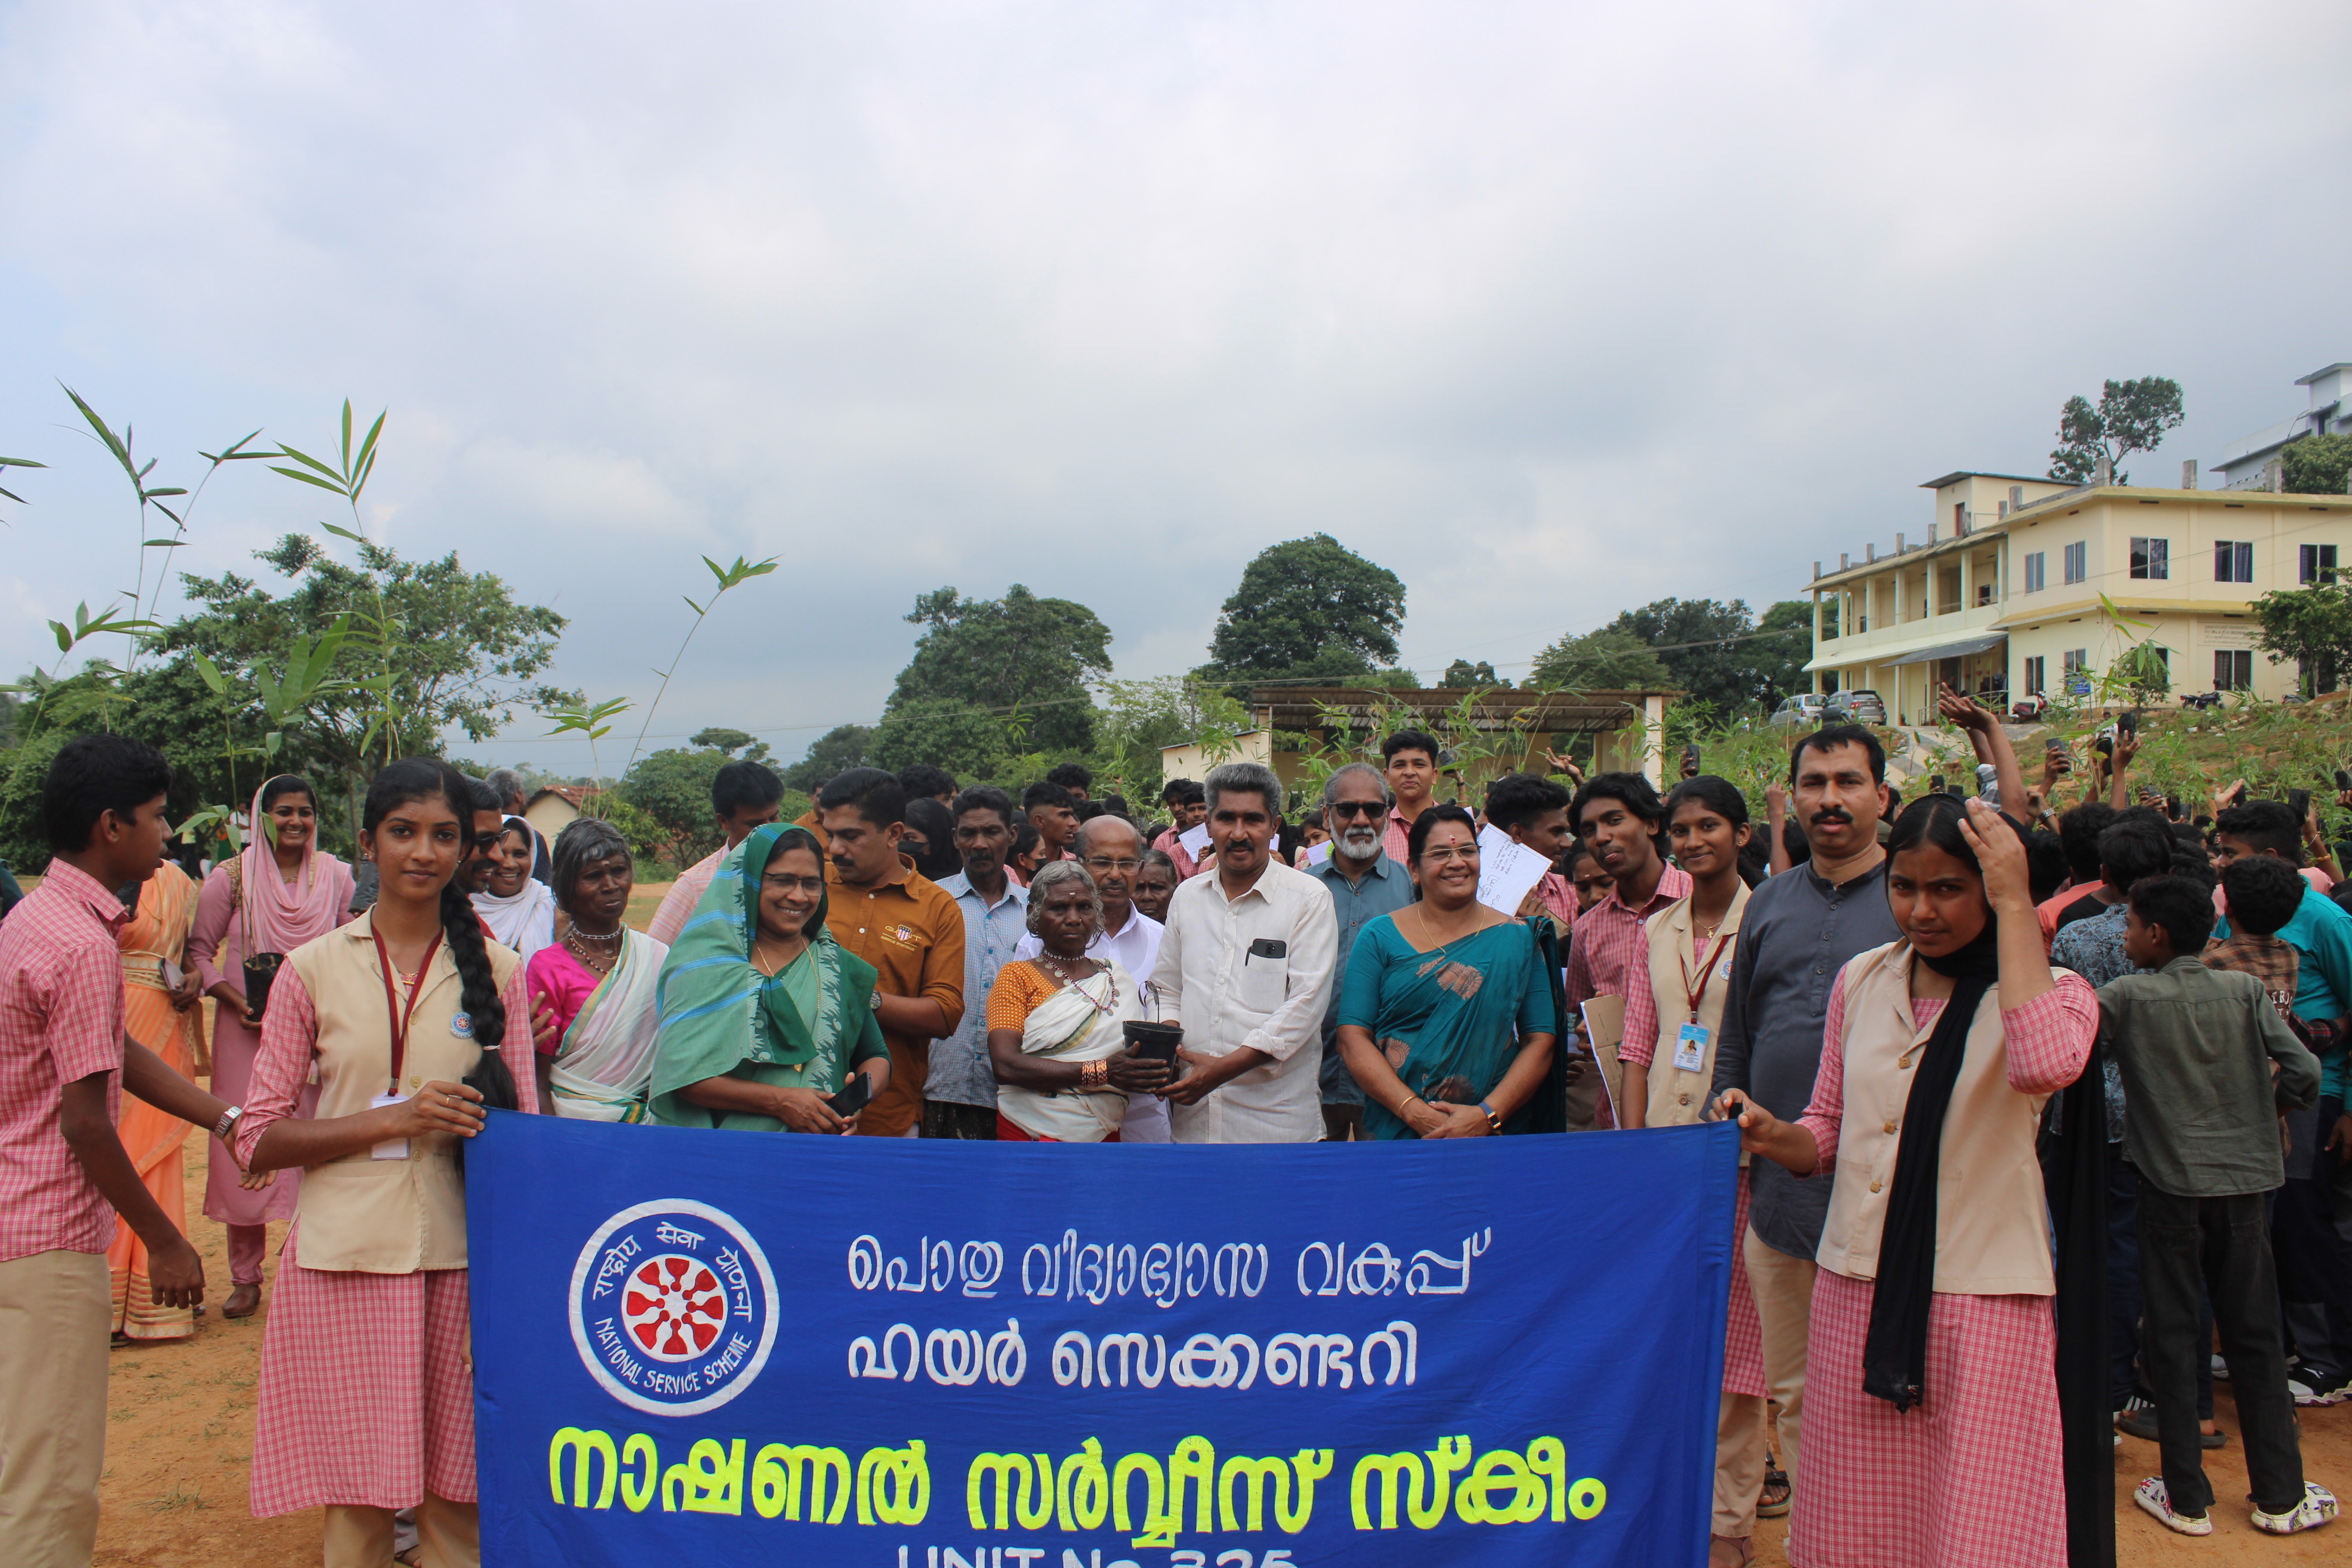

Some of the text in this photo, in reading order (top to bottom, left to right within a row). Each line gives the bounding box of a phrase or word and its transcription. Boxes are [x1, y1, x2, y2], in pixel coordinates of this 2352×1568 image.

[656, 1221, 706, 1250] सेवा
[715, 1246, 753, 1323] योजना
[848, 1226, 1492, 1309] പൊതു വിദ്യാഭ്യാസ വകുപ്പ്
[594, 1317, 752, 1395] NATIONAL SERVICE SCHEME
[848, 1317, 1417, 1391] ഹയർ സെക്കണ്ടറി
[549, 1426, 931, 1526] നാഷണൽ
[1350, 1435, 1607, 1530] സ്കീം
